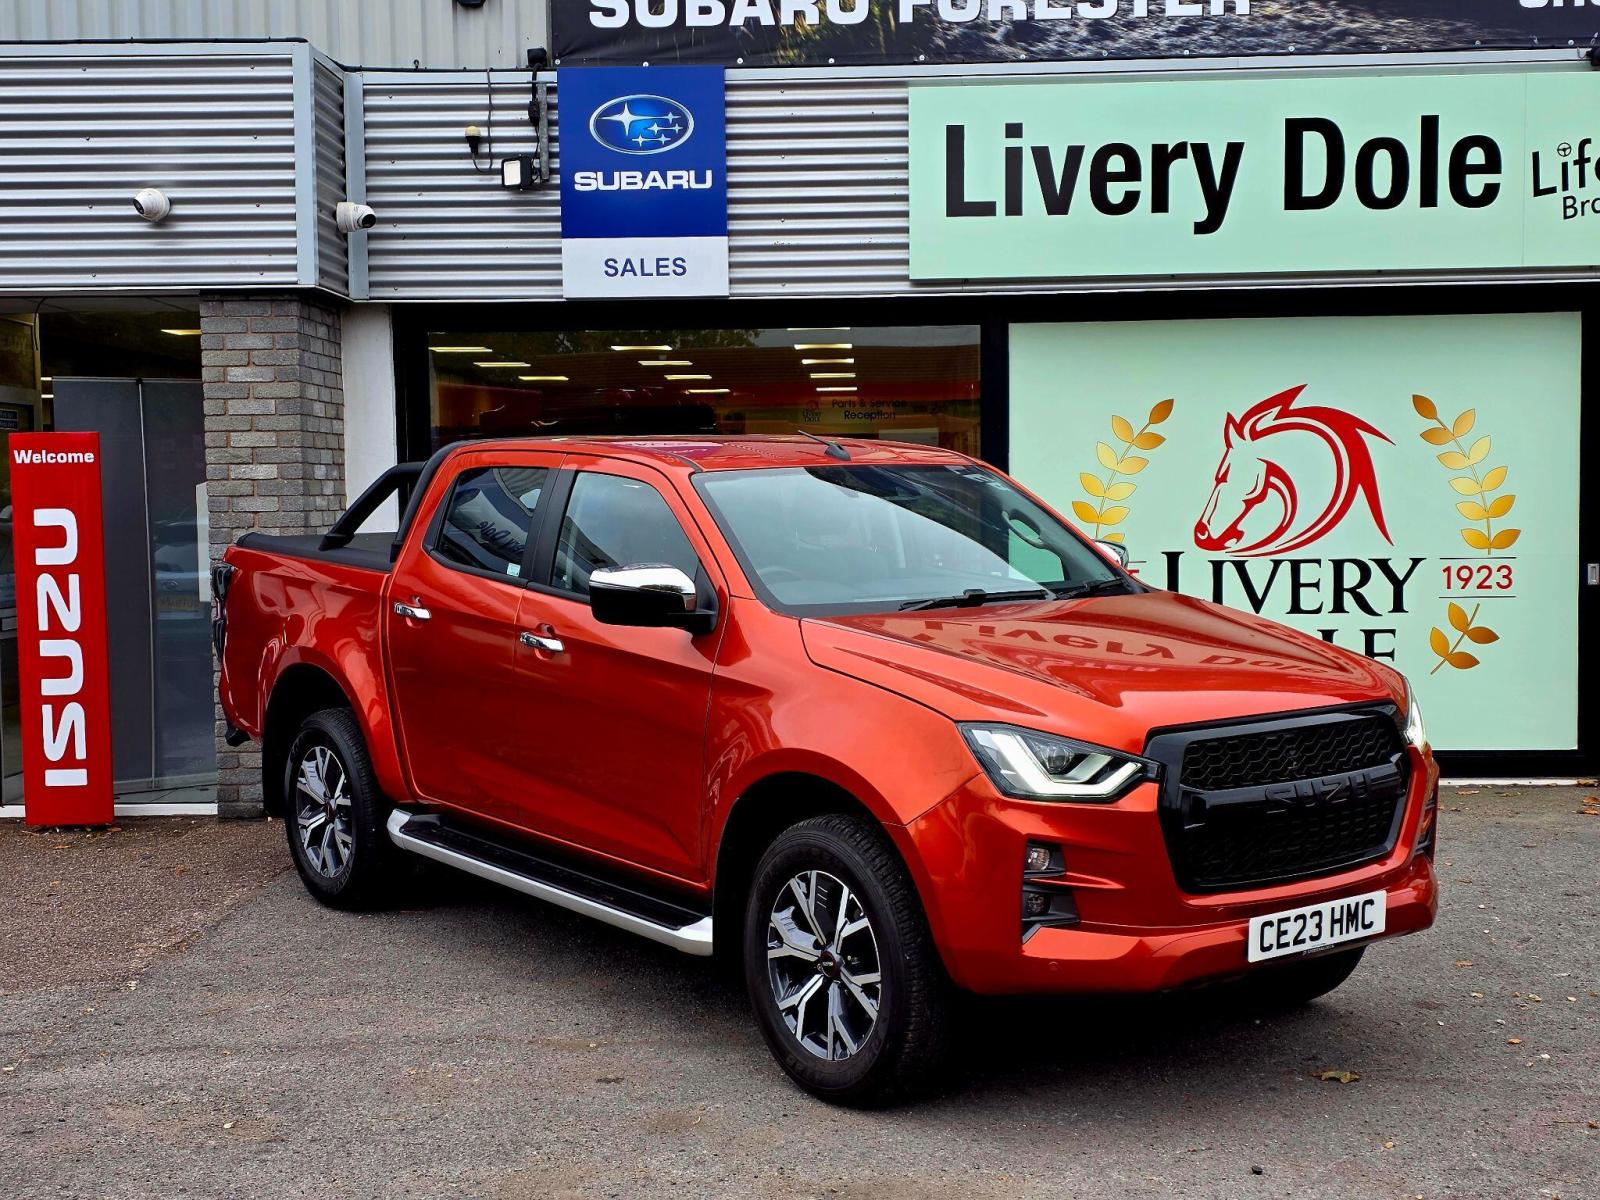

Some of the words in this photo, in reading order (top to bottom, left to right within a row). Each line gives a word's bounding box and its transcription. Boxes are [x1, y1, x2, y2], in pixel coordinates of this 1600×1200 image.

[574, 169, 713, 191] SUBARU
[946, 123, 1245, 235] Livery
[1284, 115, 1502, 211] Dole
[604, 257, 687, 277] SALES
[844, 410, 896, 421] Reception
[13, 449, 95, 464] Welcome
[1442, 564, 1513, 589] 1923
[33, 508, 88, 787] ISUZU
[1259, 910, 1323, 953] CE23
[1330, 899, 1375, 938] HMC
